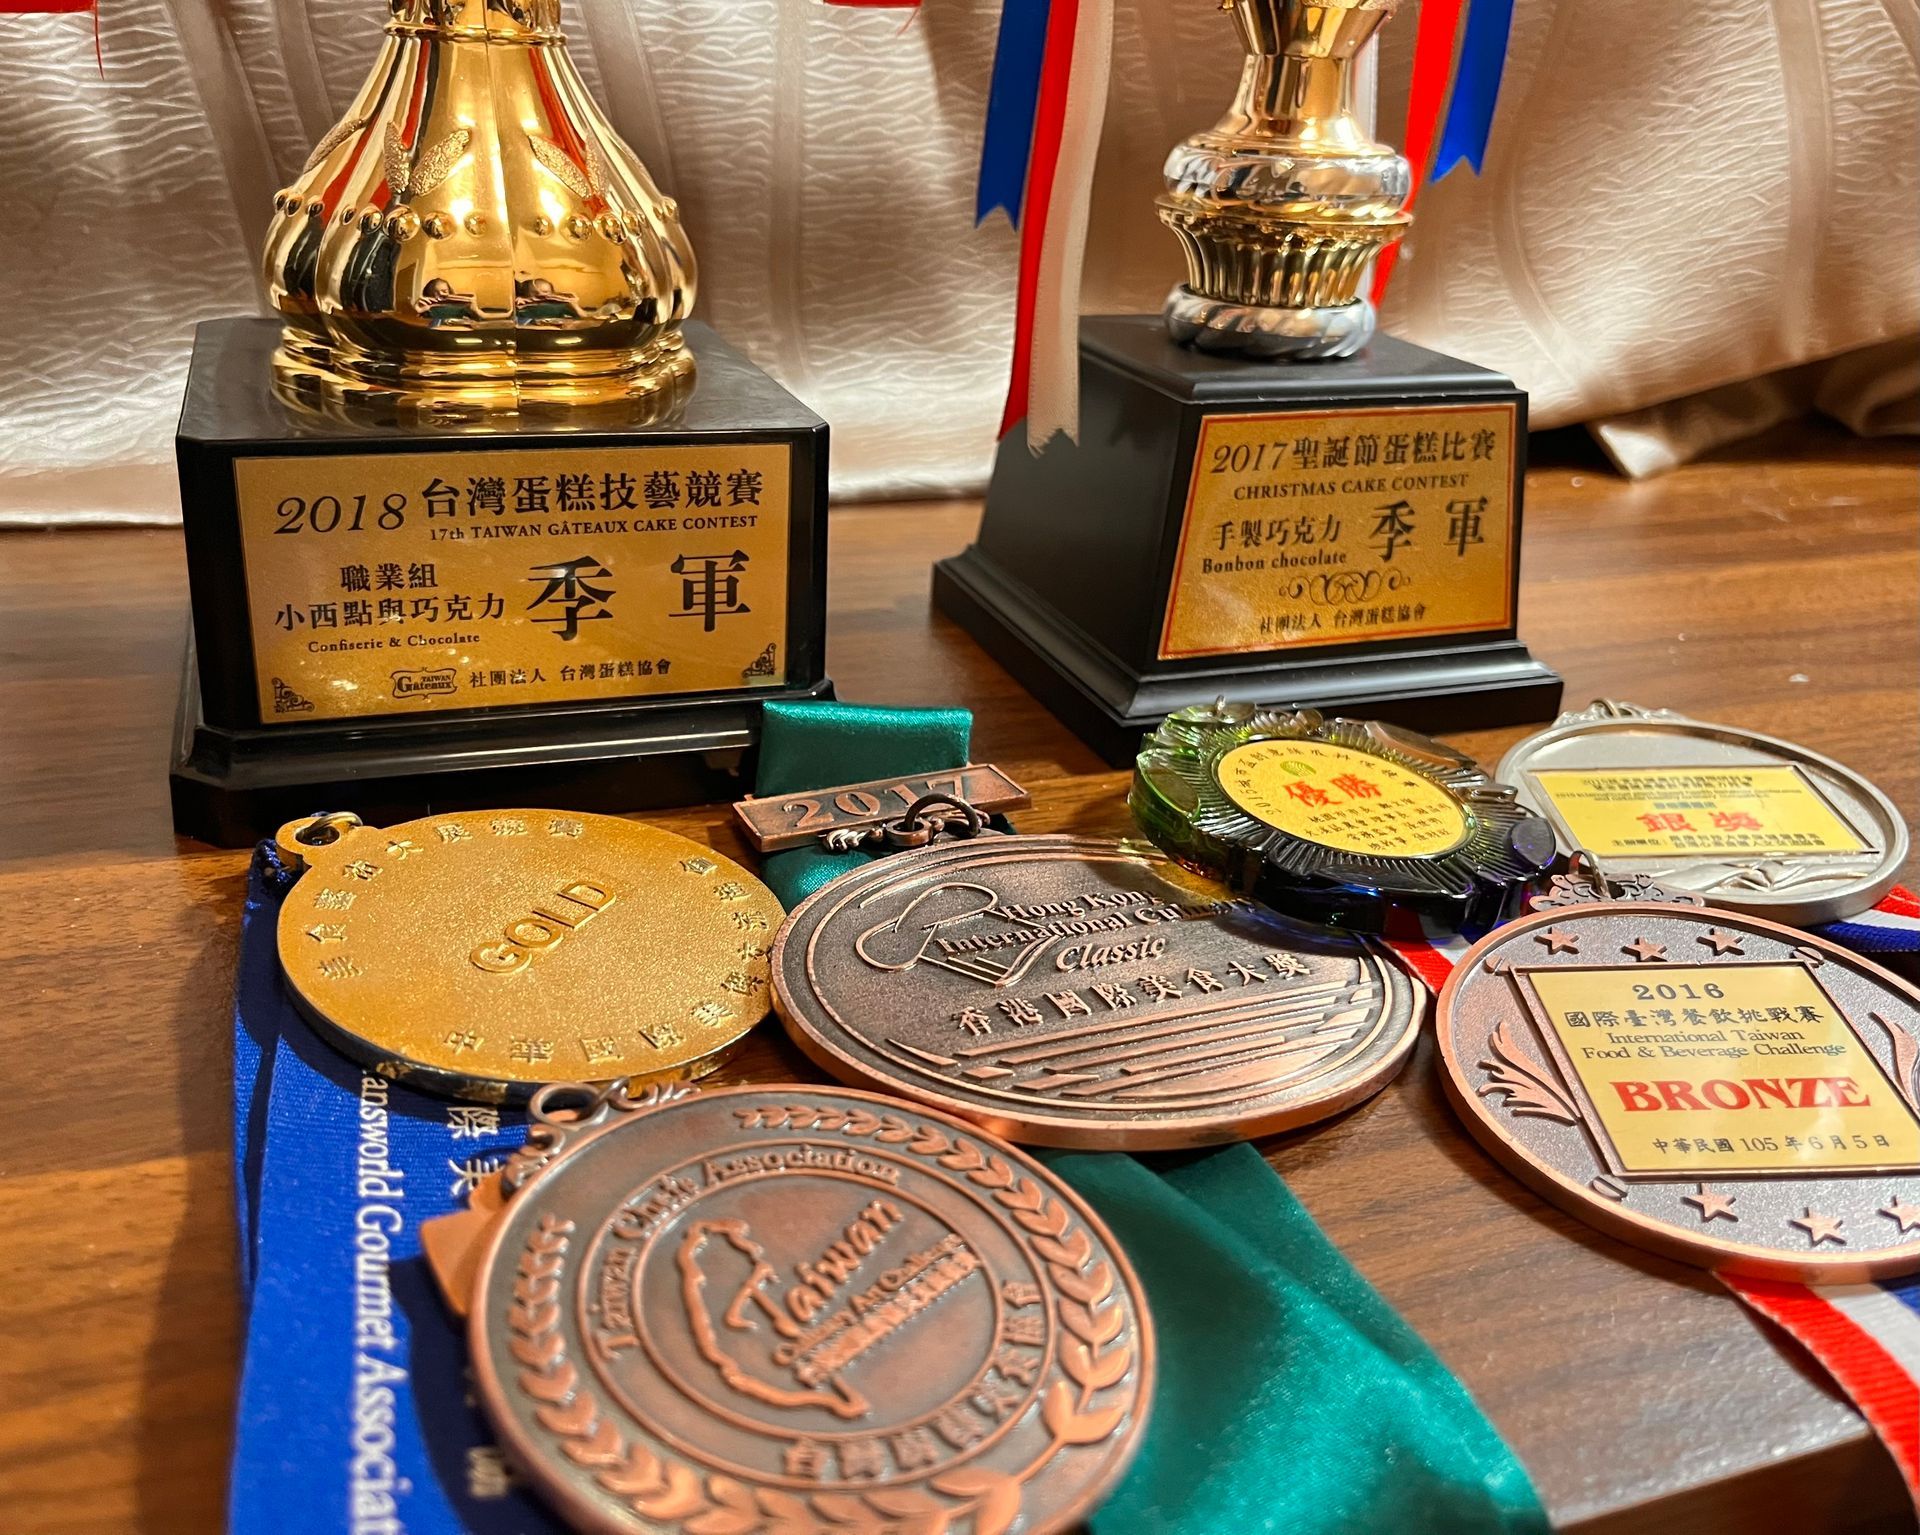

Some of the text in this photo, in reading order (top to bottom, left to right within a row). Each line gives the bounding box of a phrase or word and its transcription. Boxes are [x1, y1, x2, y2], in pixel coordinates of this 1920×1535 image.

[422, 467, 764, 519] 台灣蛋糕技藝競賽
[1234, 473, 1469, 501] CHRISTMAS CAKE CONTEST
[273, 493, 407, 535] 2018
[430, 514, 758, 541] 17th TAIWAN GÂTEAUX CAKE CONTEST
[1212, 514, 1342, 551] 手製巧克力
[340, 562, 438, 592] 職業組
[1202, 551, 1347, 575] Bonbon chocolate
[274, 593, 506, 631] 小西點與巧克力
[308, 632, 480, 653] Confiserie & Chocolate
[421, 674, 451, 682] TAIWAN
[470, 658, 672, 688] 社團法人 台灣蛋糕協會
[782, 774, 965, 828] 2017
[1283, 773, 1382, 808] 優勝
[470, 878, 617, 975] GOLD
[1000, 900, 1077, 921] Hong
[934, 911, 1132, 954] International
[1056, 934, 1167, 973] Classic
[1632, 983, 1725, 1001] 2016
[1564, 1005, 1825, 1028] 國際臺灣餐飲挑戰賽
[1582, 1042, 1848, 1060] Food & Beverage Challenge
[1606, 1029, 1805, 1045] International Taiwan
[1610, 1076, 1872, 1113] BRONZE
[358, 1070, 404, 1198] answorld
[703, 1142, 900, 1187] Association
[355, 1204, 403, 1351] Gourmet
[724, 1199, 904, 1338] Taiwan
